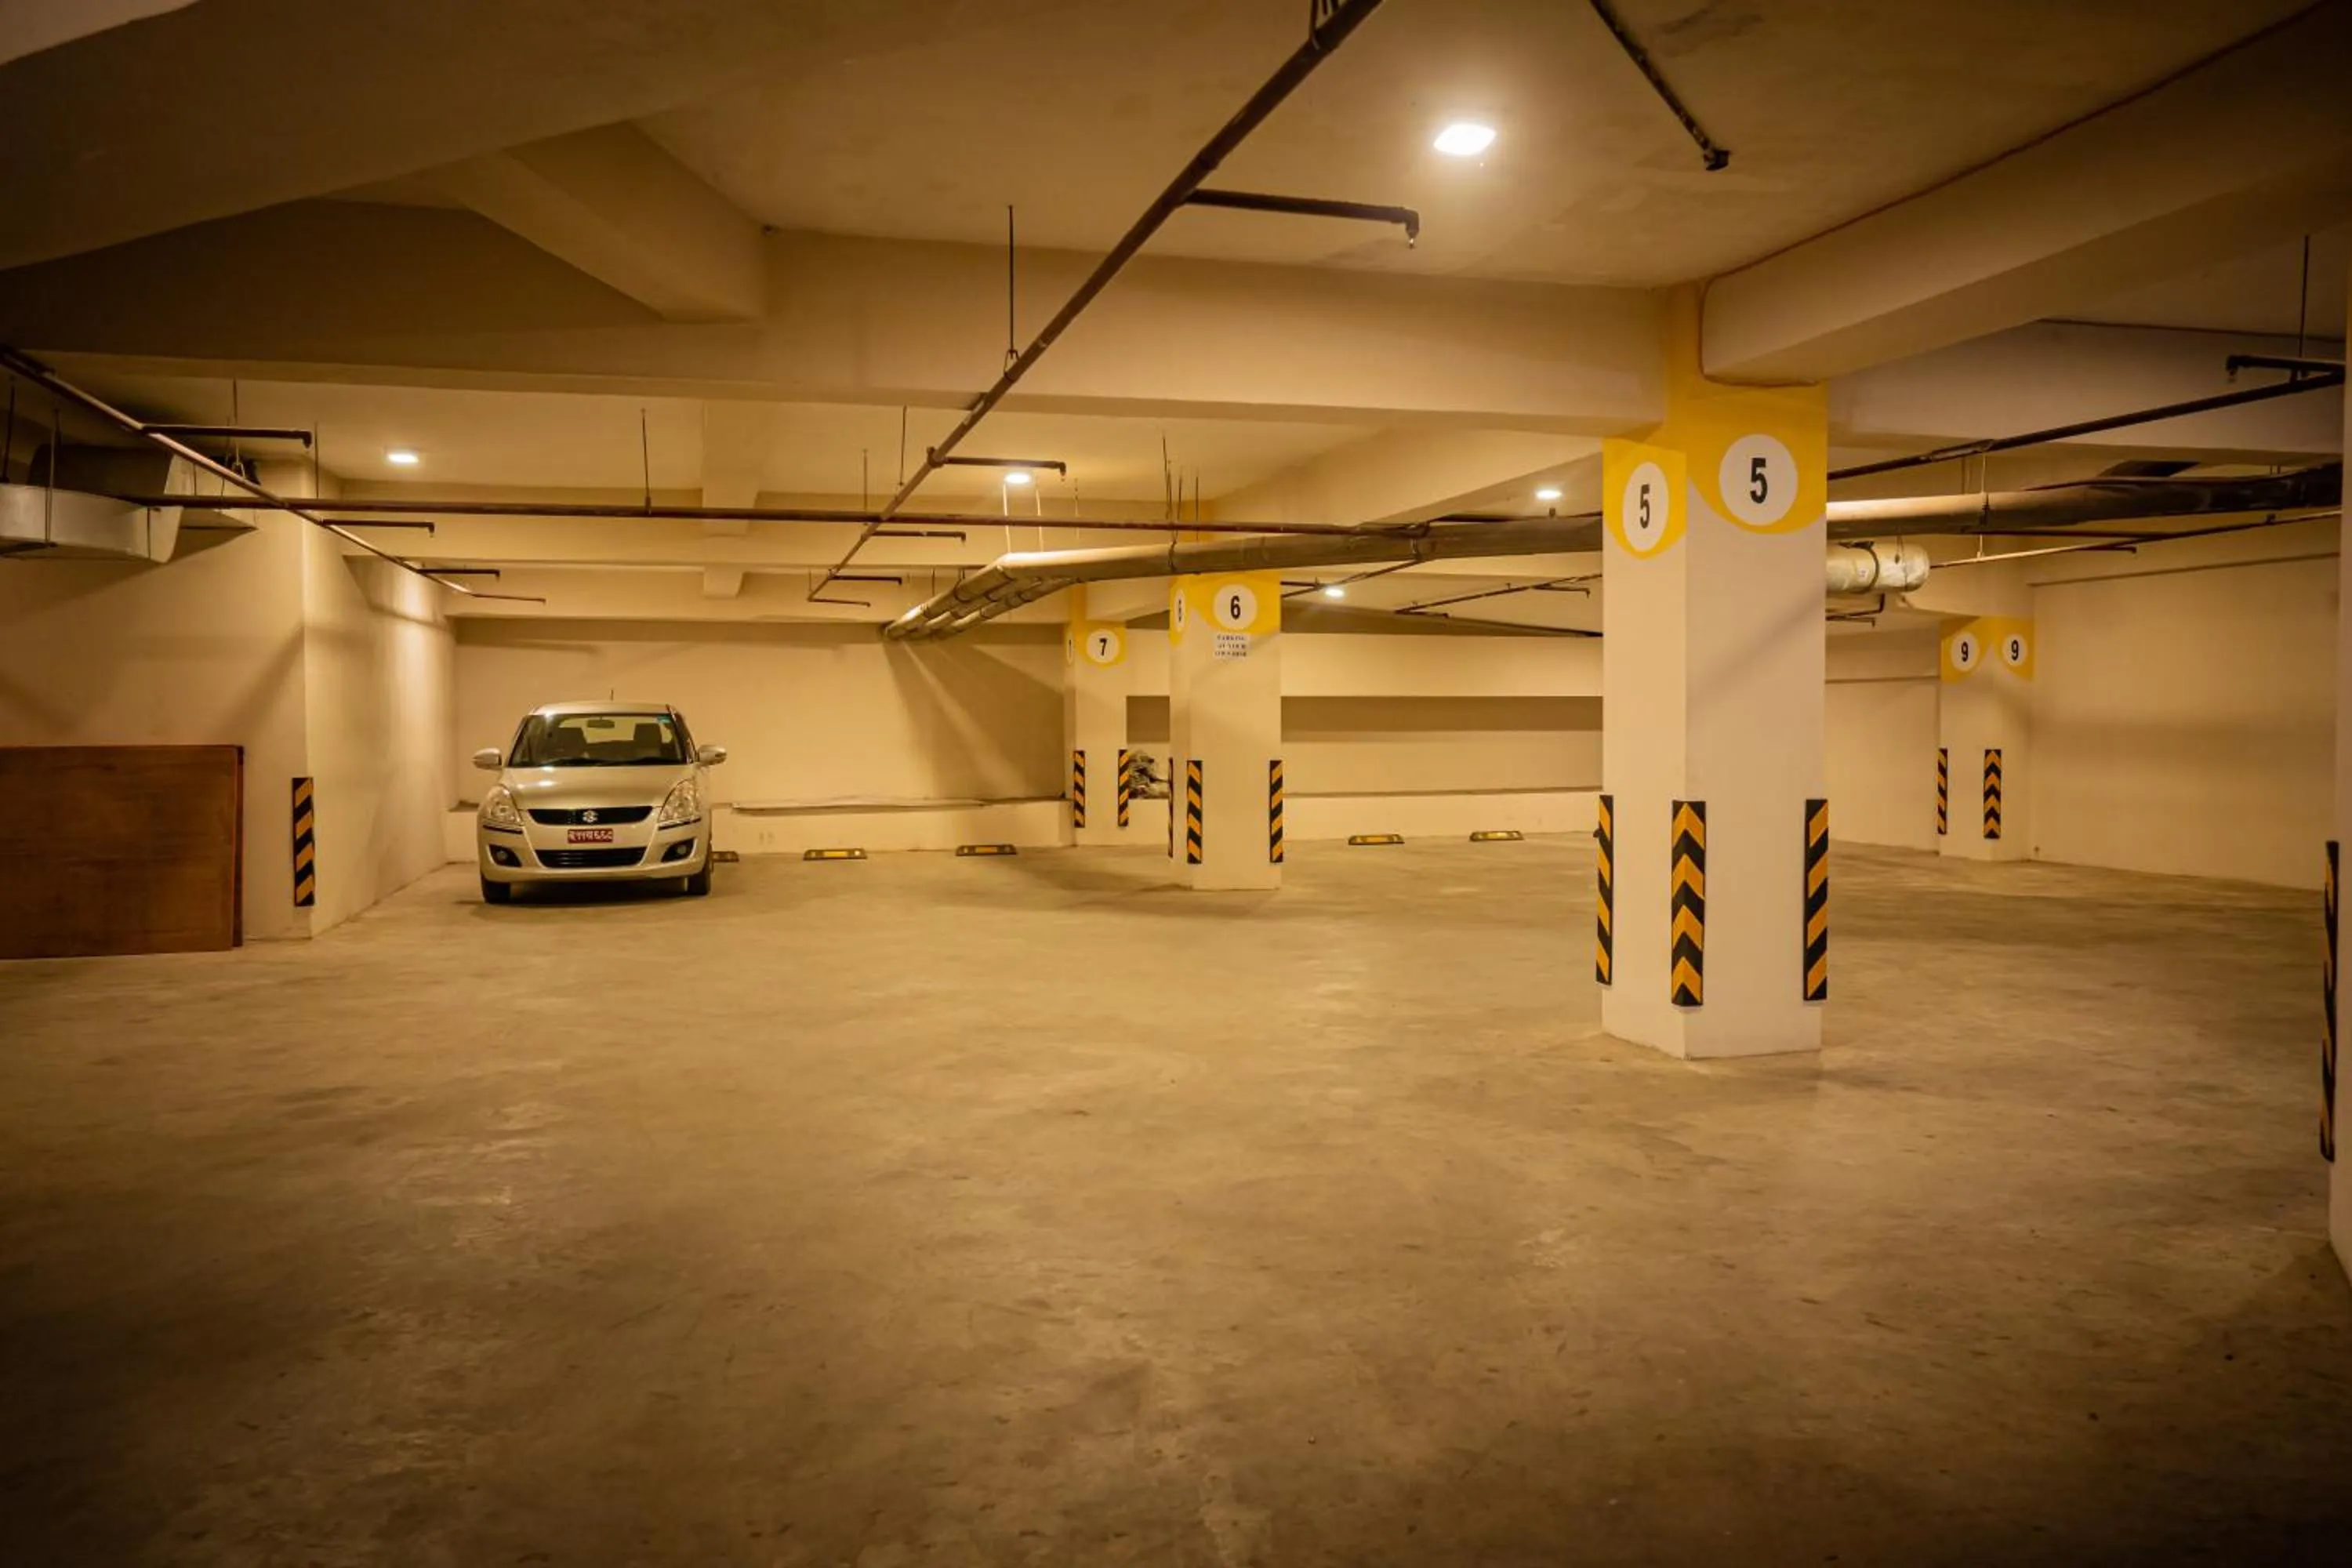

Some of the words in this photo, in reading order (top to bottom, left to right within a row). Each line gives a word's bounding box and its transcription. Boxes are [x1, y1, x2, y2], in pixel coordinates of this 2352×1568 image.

[1750, 457, 1768, 504] 5
[1639, 484, 1650, 529] 5
[1230, 595, 1241, 620] 6
[1099, 637, 1108, 656] 7
[1961, 641, 1969, 662] 9
[2011, 639, 2020, 660] 9
